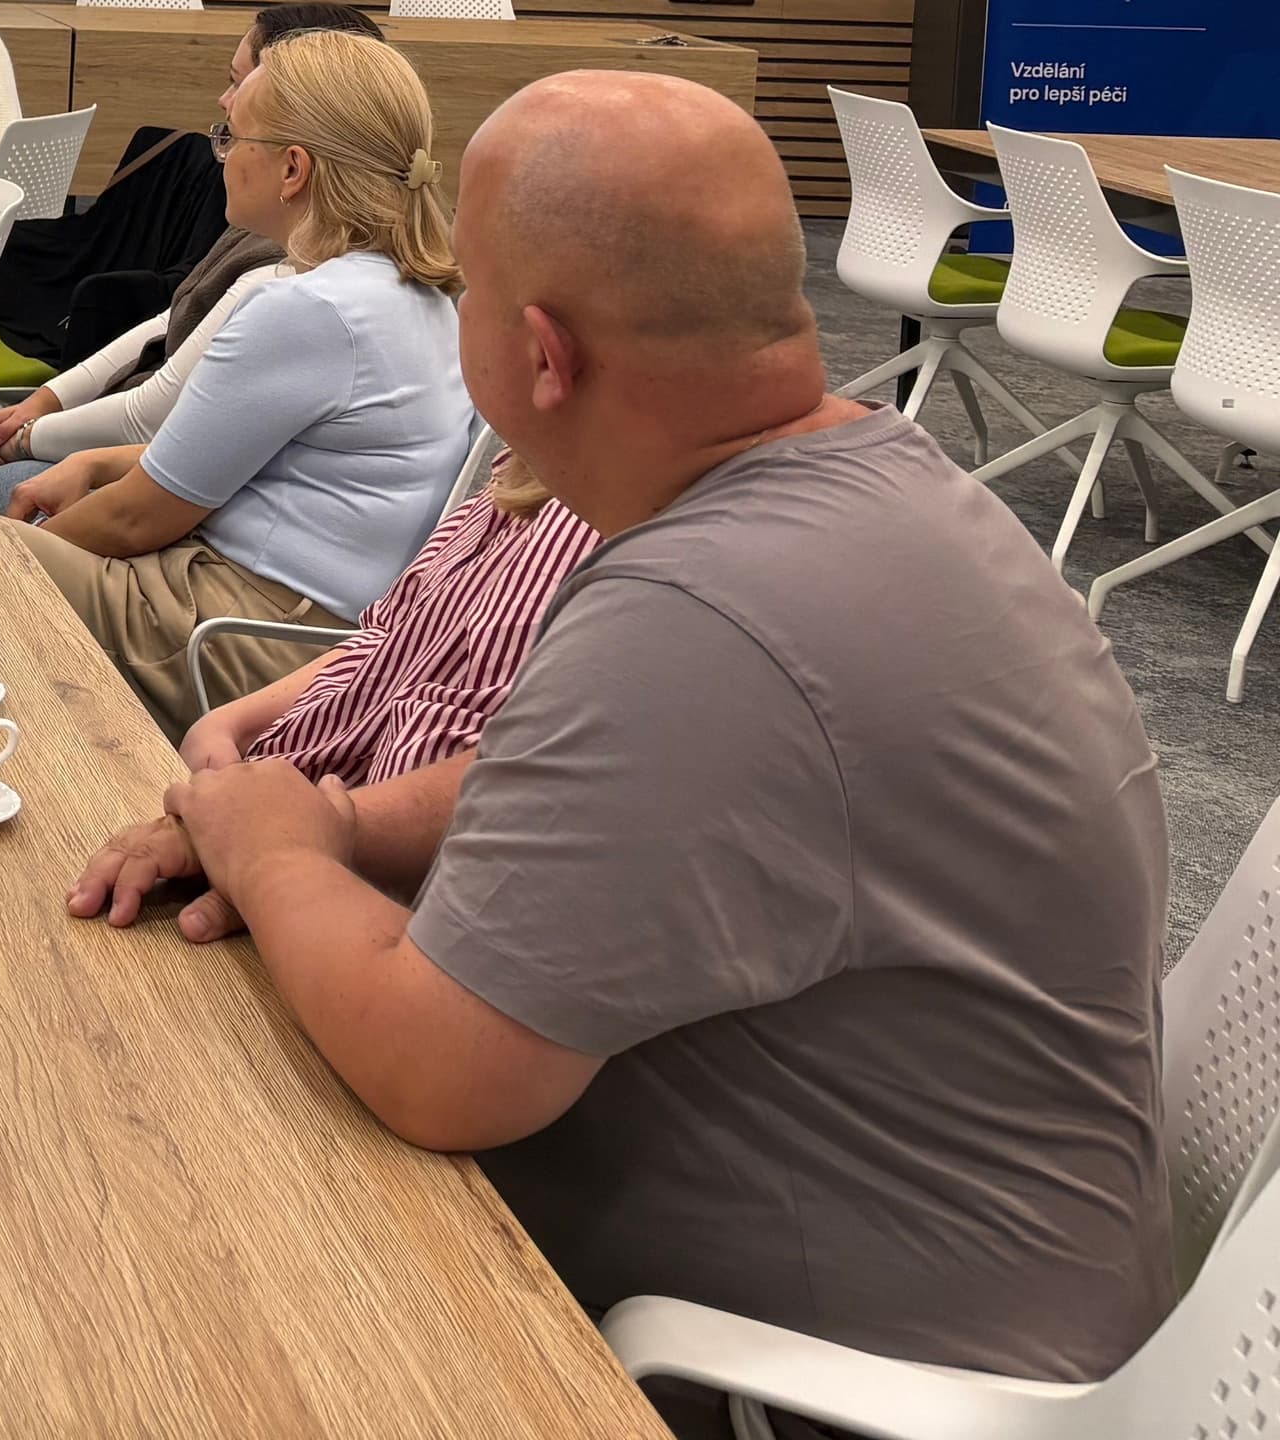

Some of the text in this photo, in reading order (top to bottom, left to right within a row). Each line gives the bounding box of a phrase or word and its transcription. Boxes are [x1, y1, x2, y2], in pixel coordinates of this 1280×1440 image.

[1010, 62, 1086, 79] Vzdělání
[1009, 85, 1127, 106] pro lepší péči
